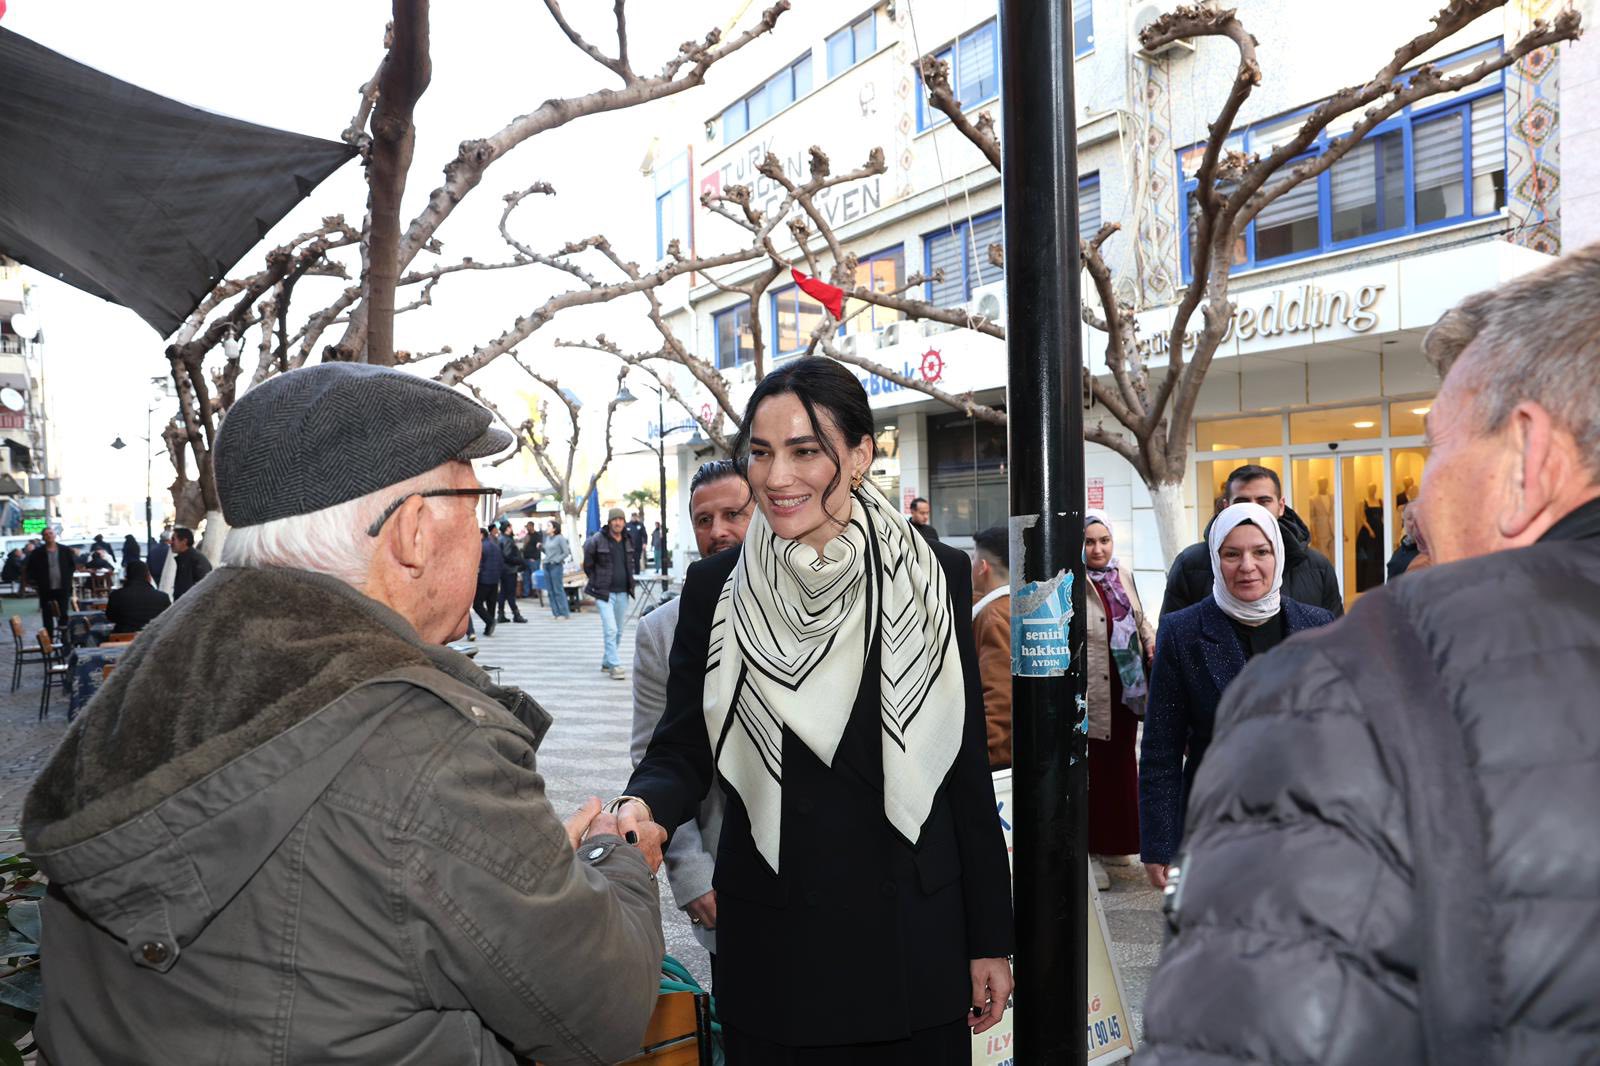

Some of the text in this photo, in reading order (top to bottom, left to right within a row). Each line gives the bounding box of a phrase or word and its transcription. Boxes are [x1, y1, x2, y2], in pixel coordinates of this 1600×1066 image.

[1221, 284, 1386, 343] edding
[1026, 628, 1063, 641] senin
[1095, 1020, 1108, 1046] 90
[1108, 1015, 1121, 1040] 45
